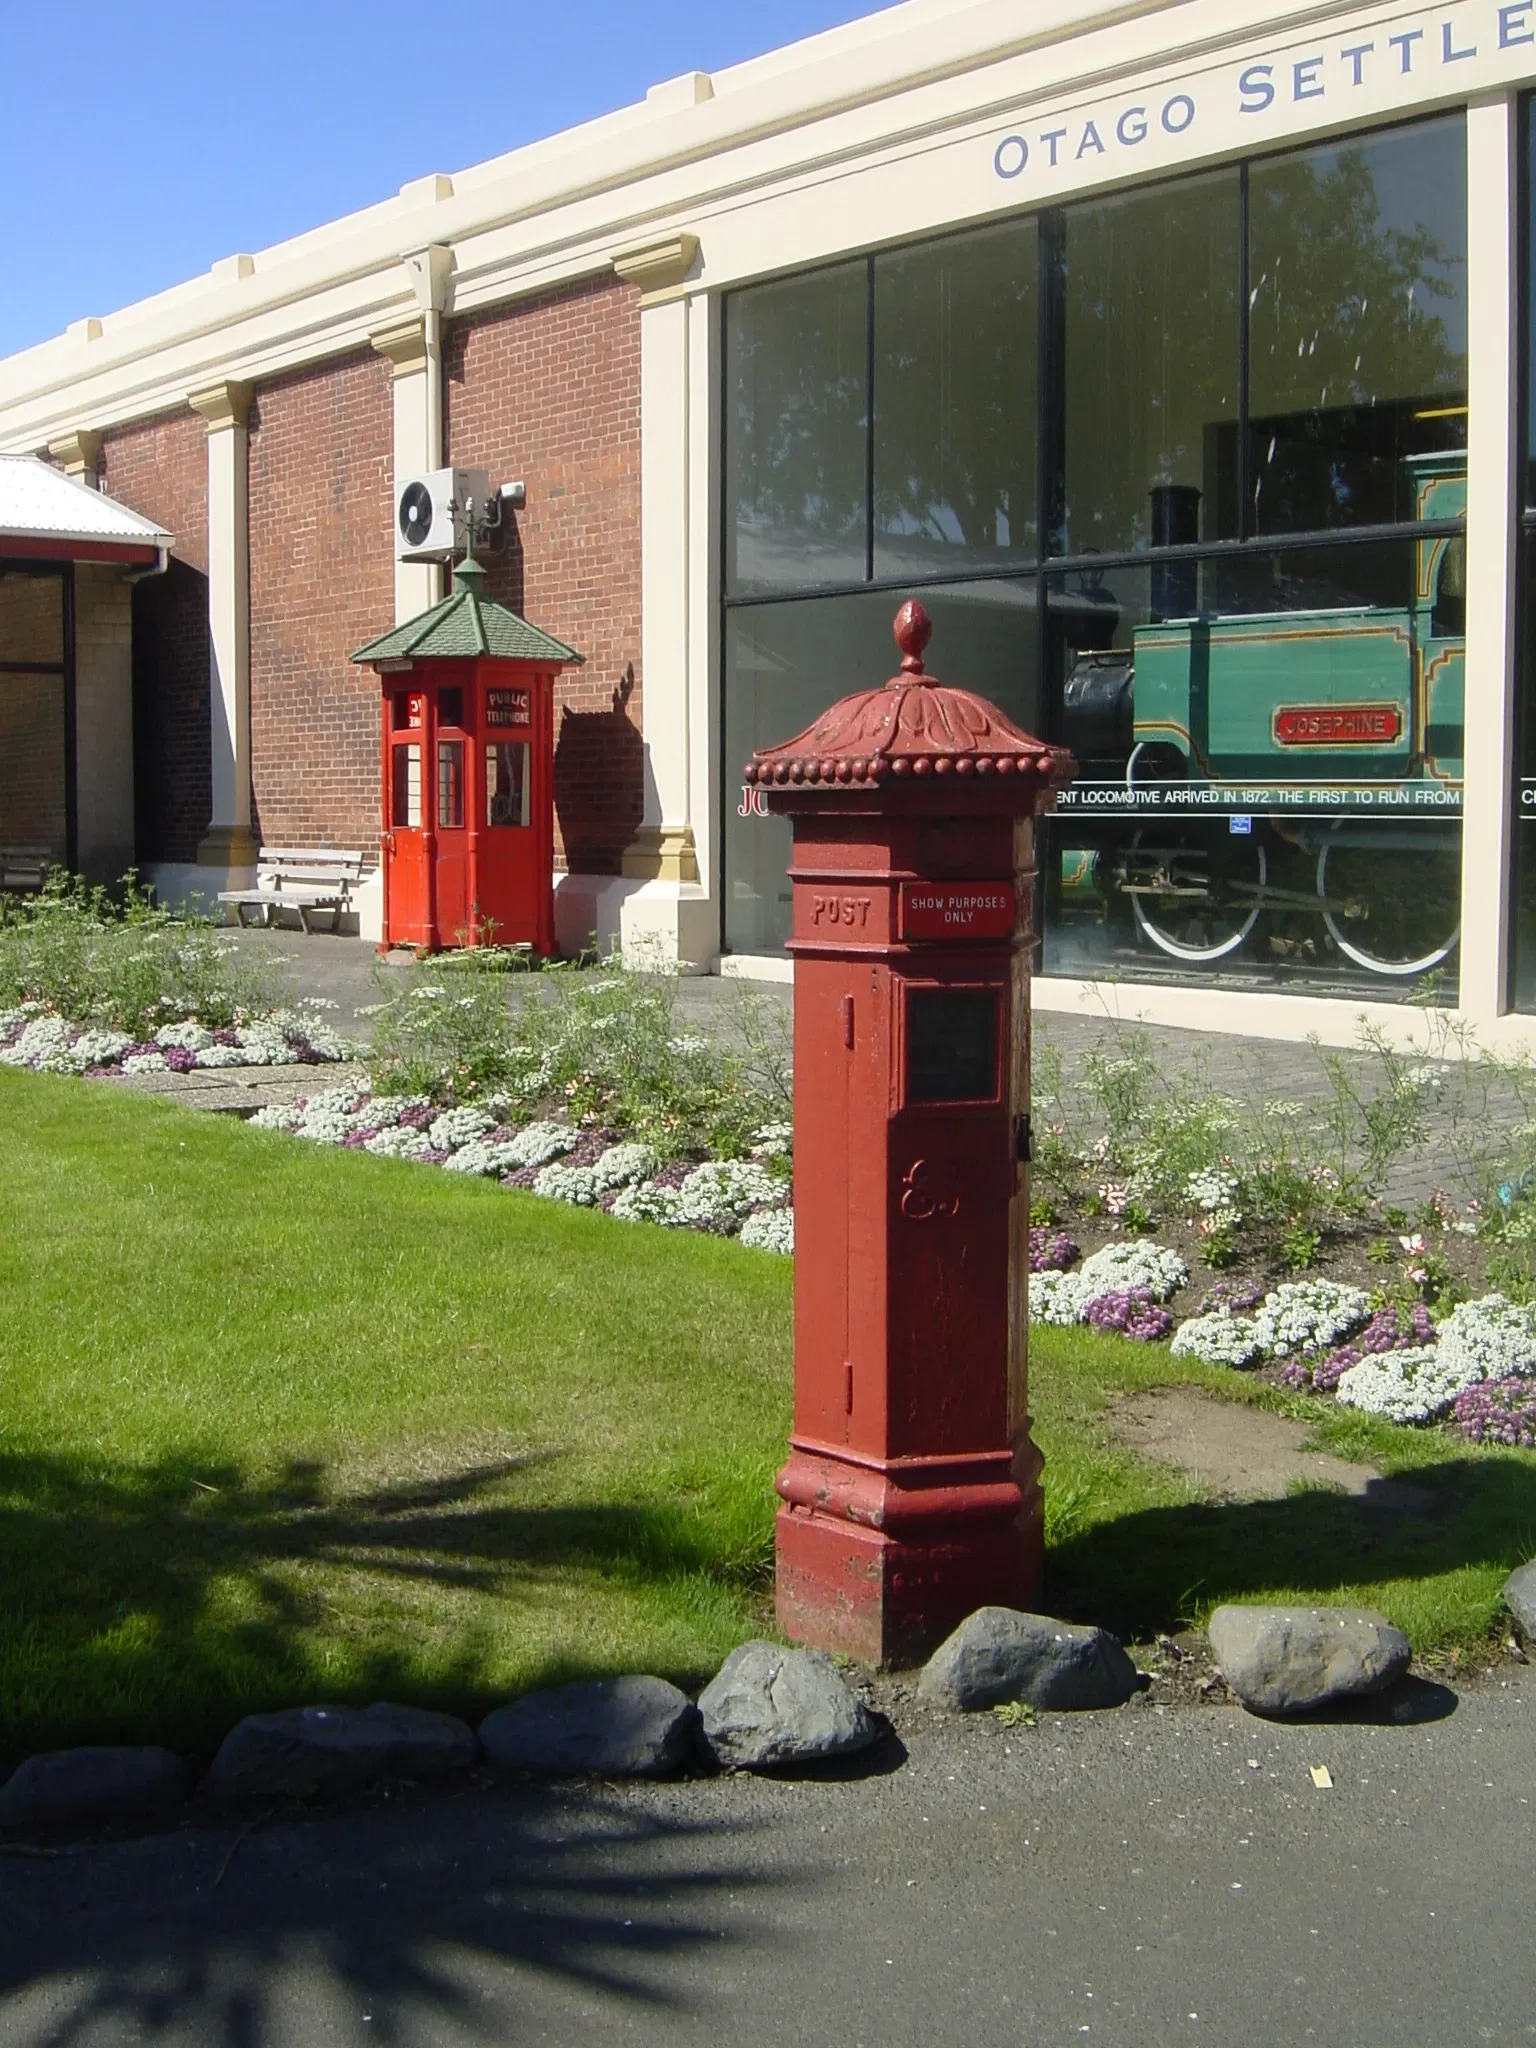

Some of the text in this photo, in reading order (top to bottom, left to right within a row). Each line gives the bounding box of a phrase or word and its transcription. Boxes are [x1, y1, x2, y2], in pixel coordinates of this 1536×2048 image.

[994, 0, 1536, 179] OTAGO SETTLE
[489, 692, 528, 708] PUBLIC
[487, 711, 530, 724] TELEPHONE
[1284, 715, 1386, 736] JOSEPHINE
[1081, 790, 1160, 804] LOCOMOTIVE
[1164, 790, 1220, 804] ARRIVED
[1223, 790, 1237, 804] IN
[1241, 790, 1272, 804] 1872.
[1277, 790, 1304, 804] THE
[1308, 790, 1348, 804] FIRST
[1353, 790, 1373, 804] TO
[1378, 790, 1410, 804] RUN
[1415, 790, 1460, 804] FROM
[911, 896, 1006, 909] SHOW PURPOSES
[810, 895, 872, 926] POST
[944, 911, 974, 923] ONLY
